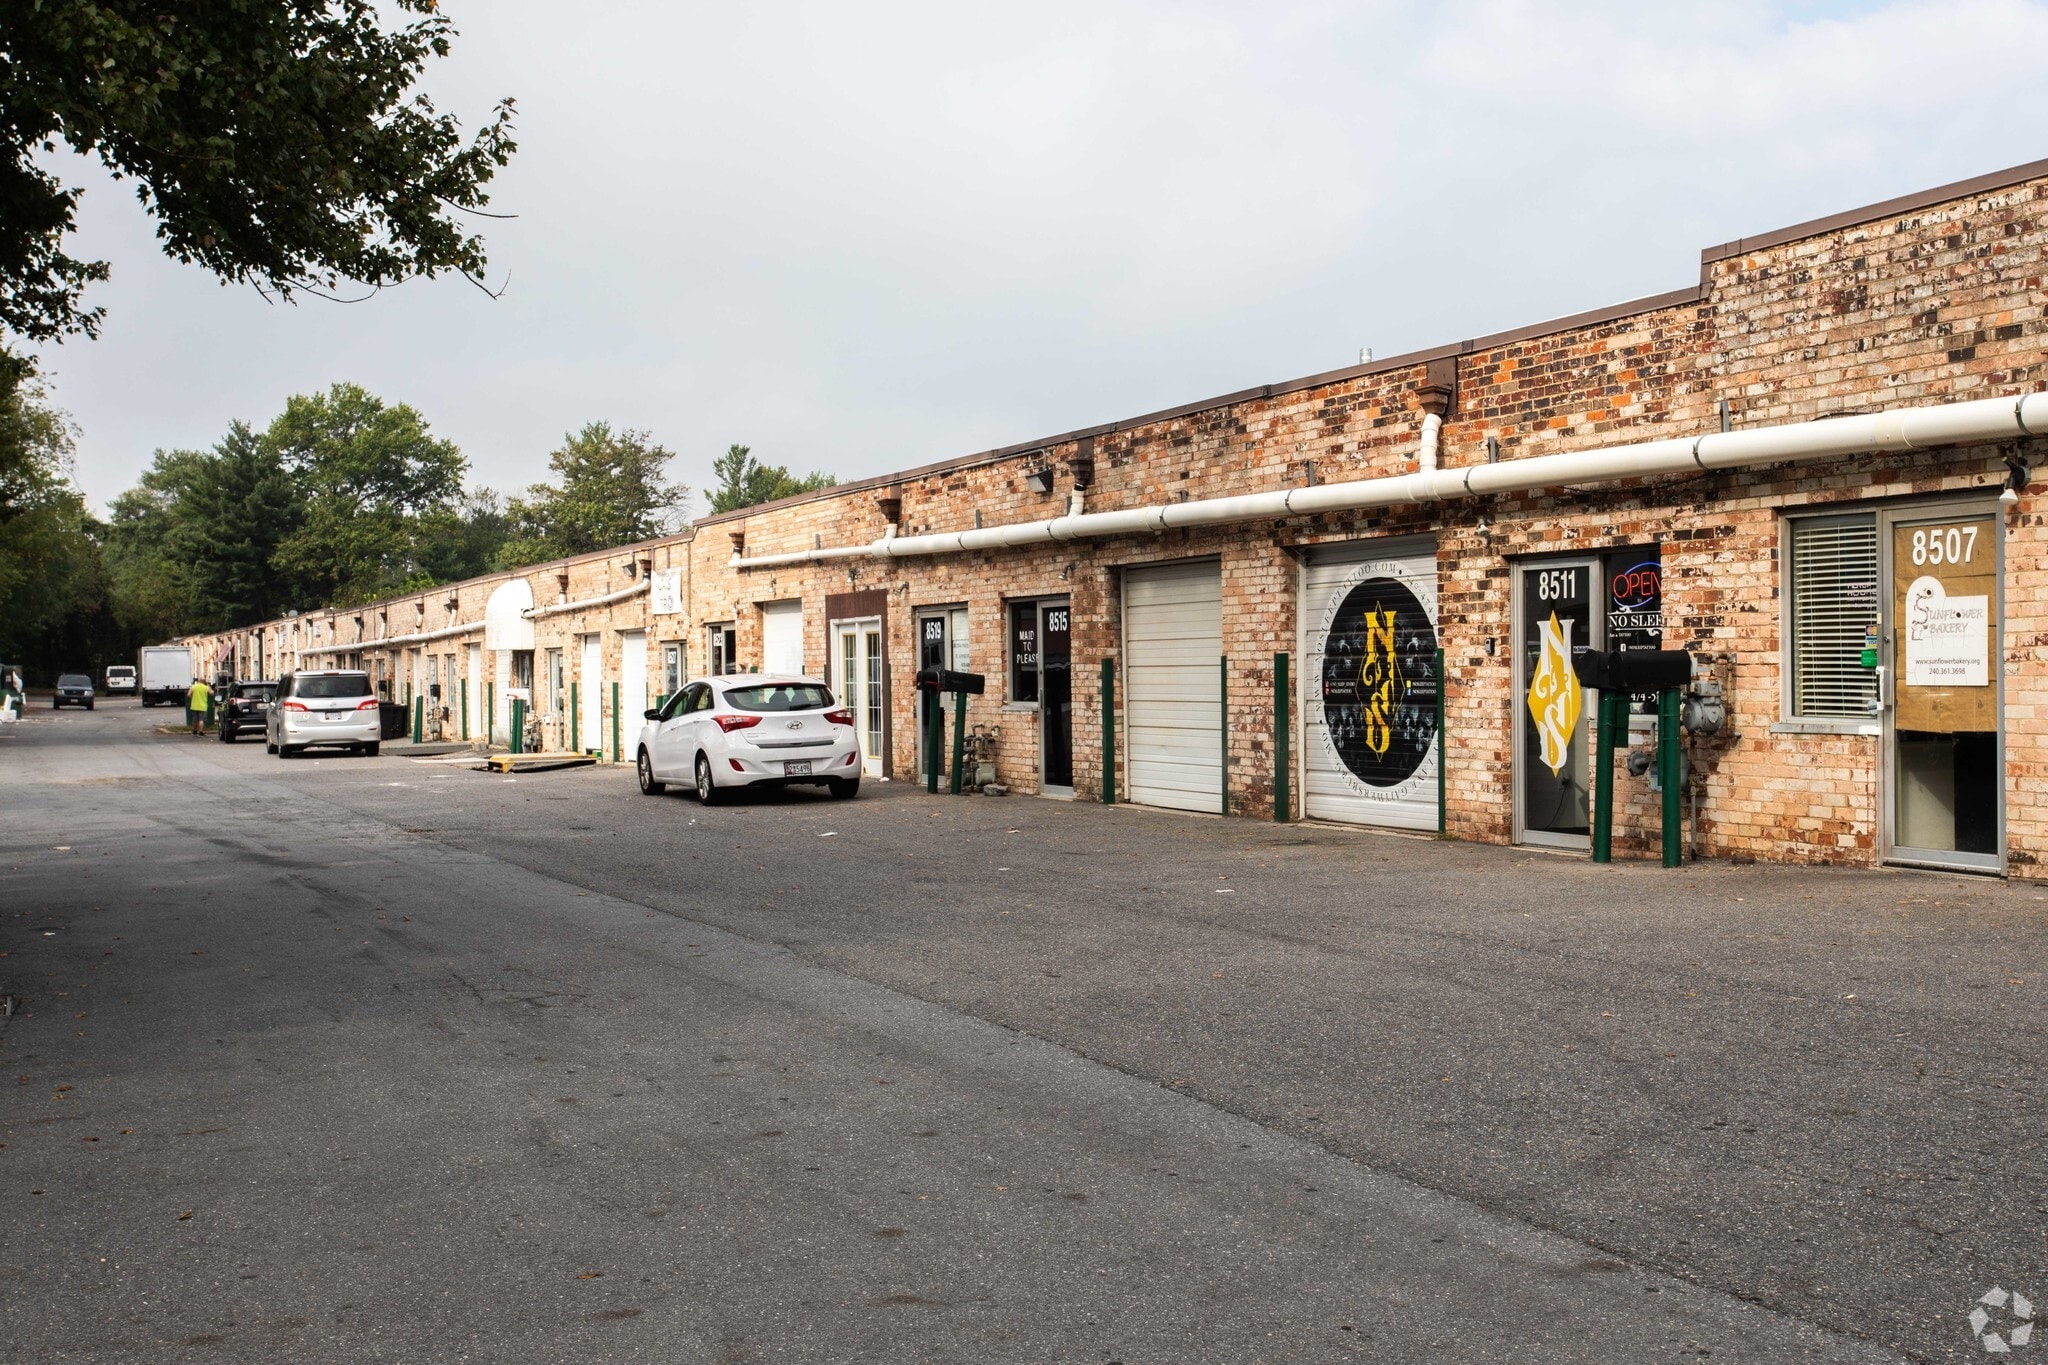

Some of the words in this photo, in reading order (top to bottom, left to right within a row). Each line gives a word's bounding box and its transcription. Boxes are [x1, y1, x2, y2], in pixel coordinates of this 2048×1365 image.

[1912, 526, 1978, 566] 8507
[1539, 569, 1576, 600] 8511
[1613, 571, 1661, 598] OPEN
[1049, 611, 1068, 631] 8515
[1608, 615, 1628, 627] NO
[926, 621, 942, 639] 8519
[1929, 622, 1968, 634] BAKERY
[1019, 630, 1035, 640] MAID
[1022, 641, 1032, 651] TO
[1915, 658, 1981, 666] www.sunflowerbakery.org
[1929, 667, 1966, 675] 240.361.3698
